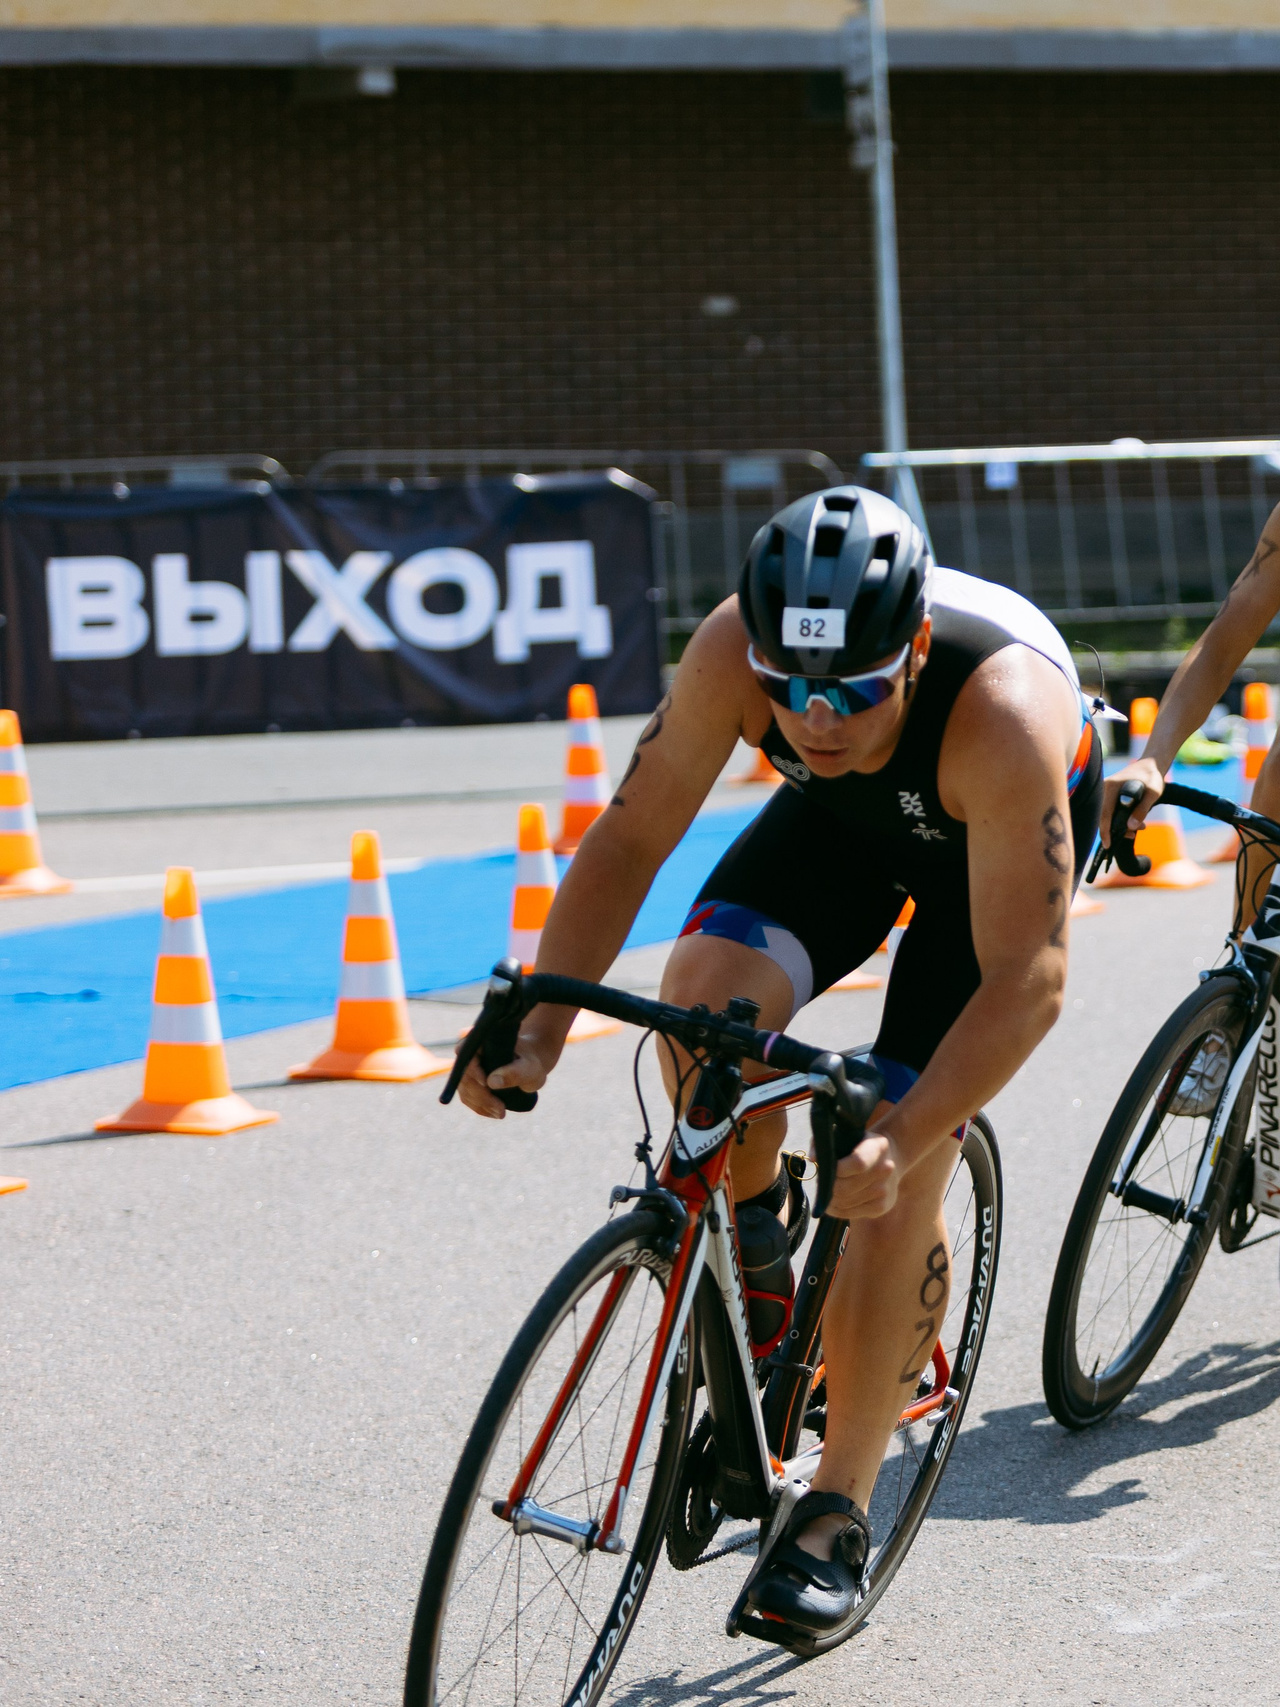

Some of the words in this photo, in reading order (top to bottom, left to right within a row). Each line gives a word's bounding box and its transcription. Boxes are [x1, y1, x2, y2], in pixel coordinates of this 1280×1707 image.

[47, 540, 613, 664] ВЫХОД
[798, 617, 827, 639] 82
[1041, 805, 1070, 949] 82
[694, 1121, 732, 1155] AUTH
[898, 1241, 949, 1385] 82
[961, 1204, 994, 1376] DURA-ACE
[572, 1561, 645, 1707] DURA-A
